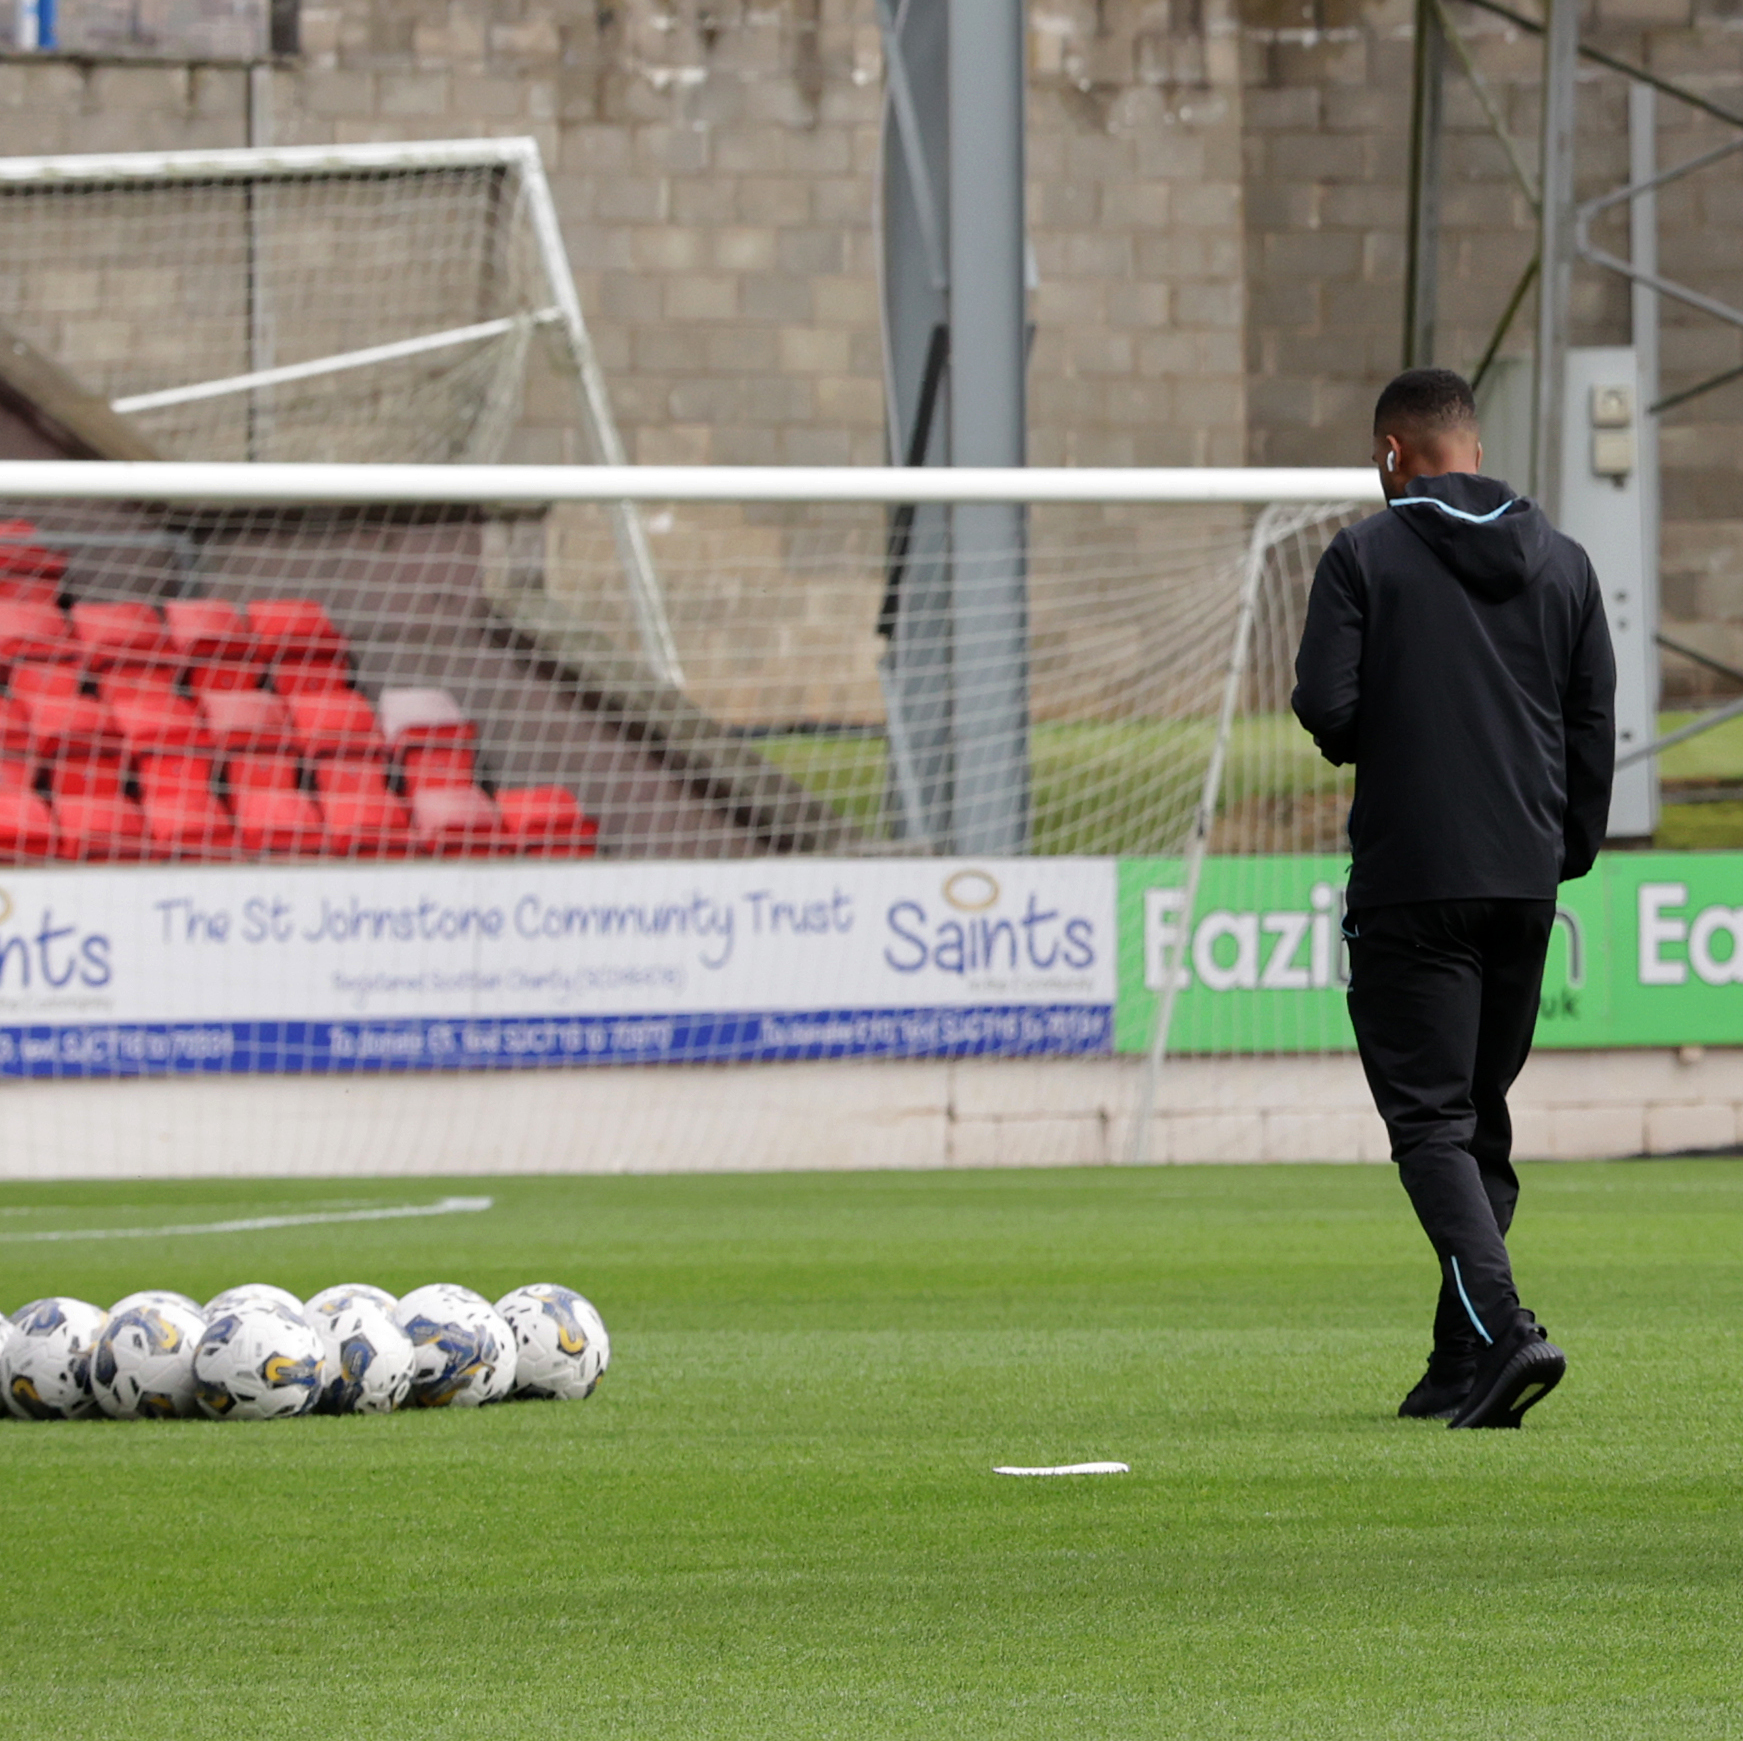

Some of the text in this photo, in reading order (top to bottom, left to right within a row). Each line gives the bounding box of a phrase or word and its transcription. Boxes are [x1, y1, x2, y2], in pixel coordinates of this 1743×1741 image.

[153, 885, 856, 970] The St Johnstone Community Trust
[884, 891, 1097, 976] Saints
